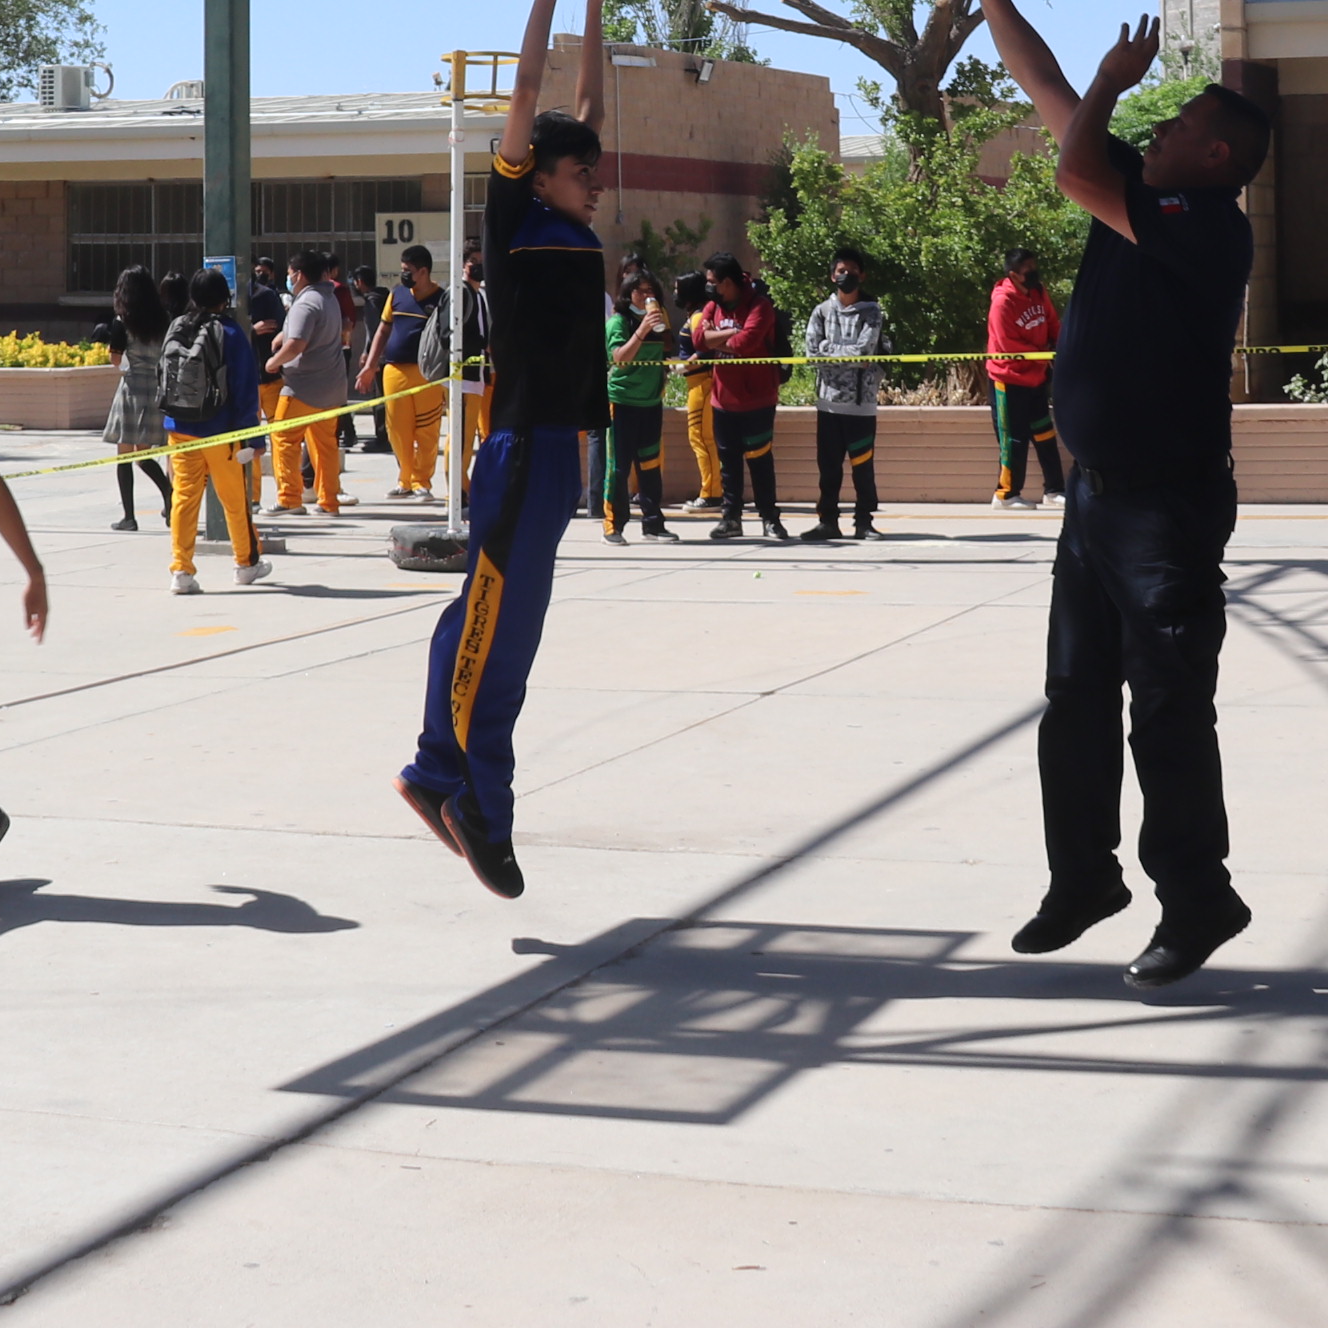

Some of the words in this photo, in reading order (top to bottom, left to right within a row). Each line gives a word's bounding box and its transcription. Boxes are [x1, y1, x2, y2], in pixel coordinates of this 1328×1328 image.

[382, 219, 414, 244] 10
[465, 574, 495, 654] TIGRES
[453, 655, 476, 697] TEC
